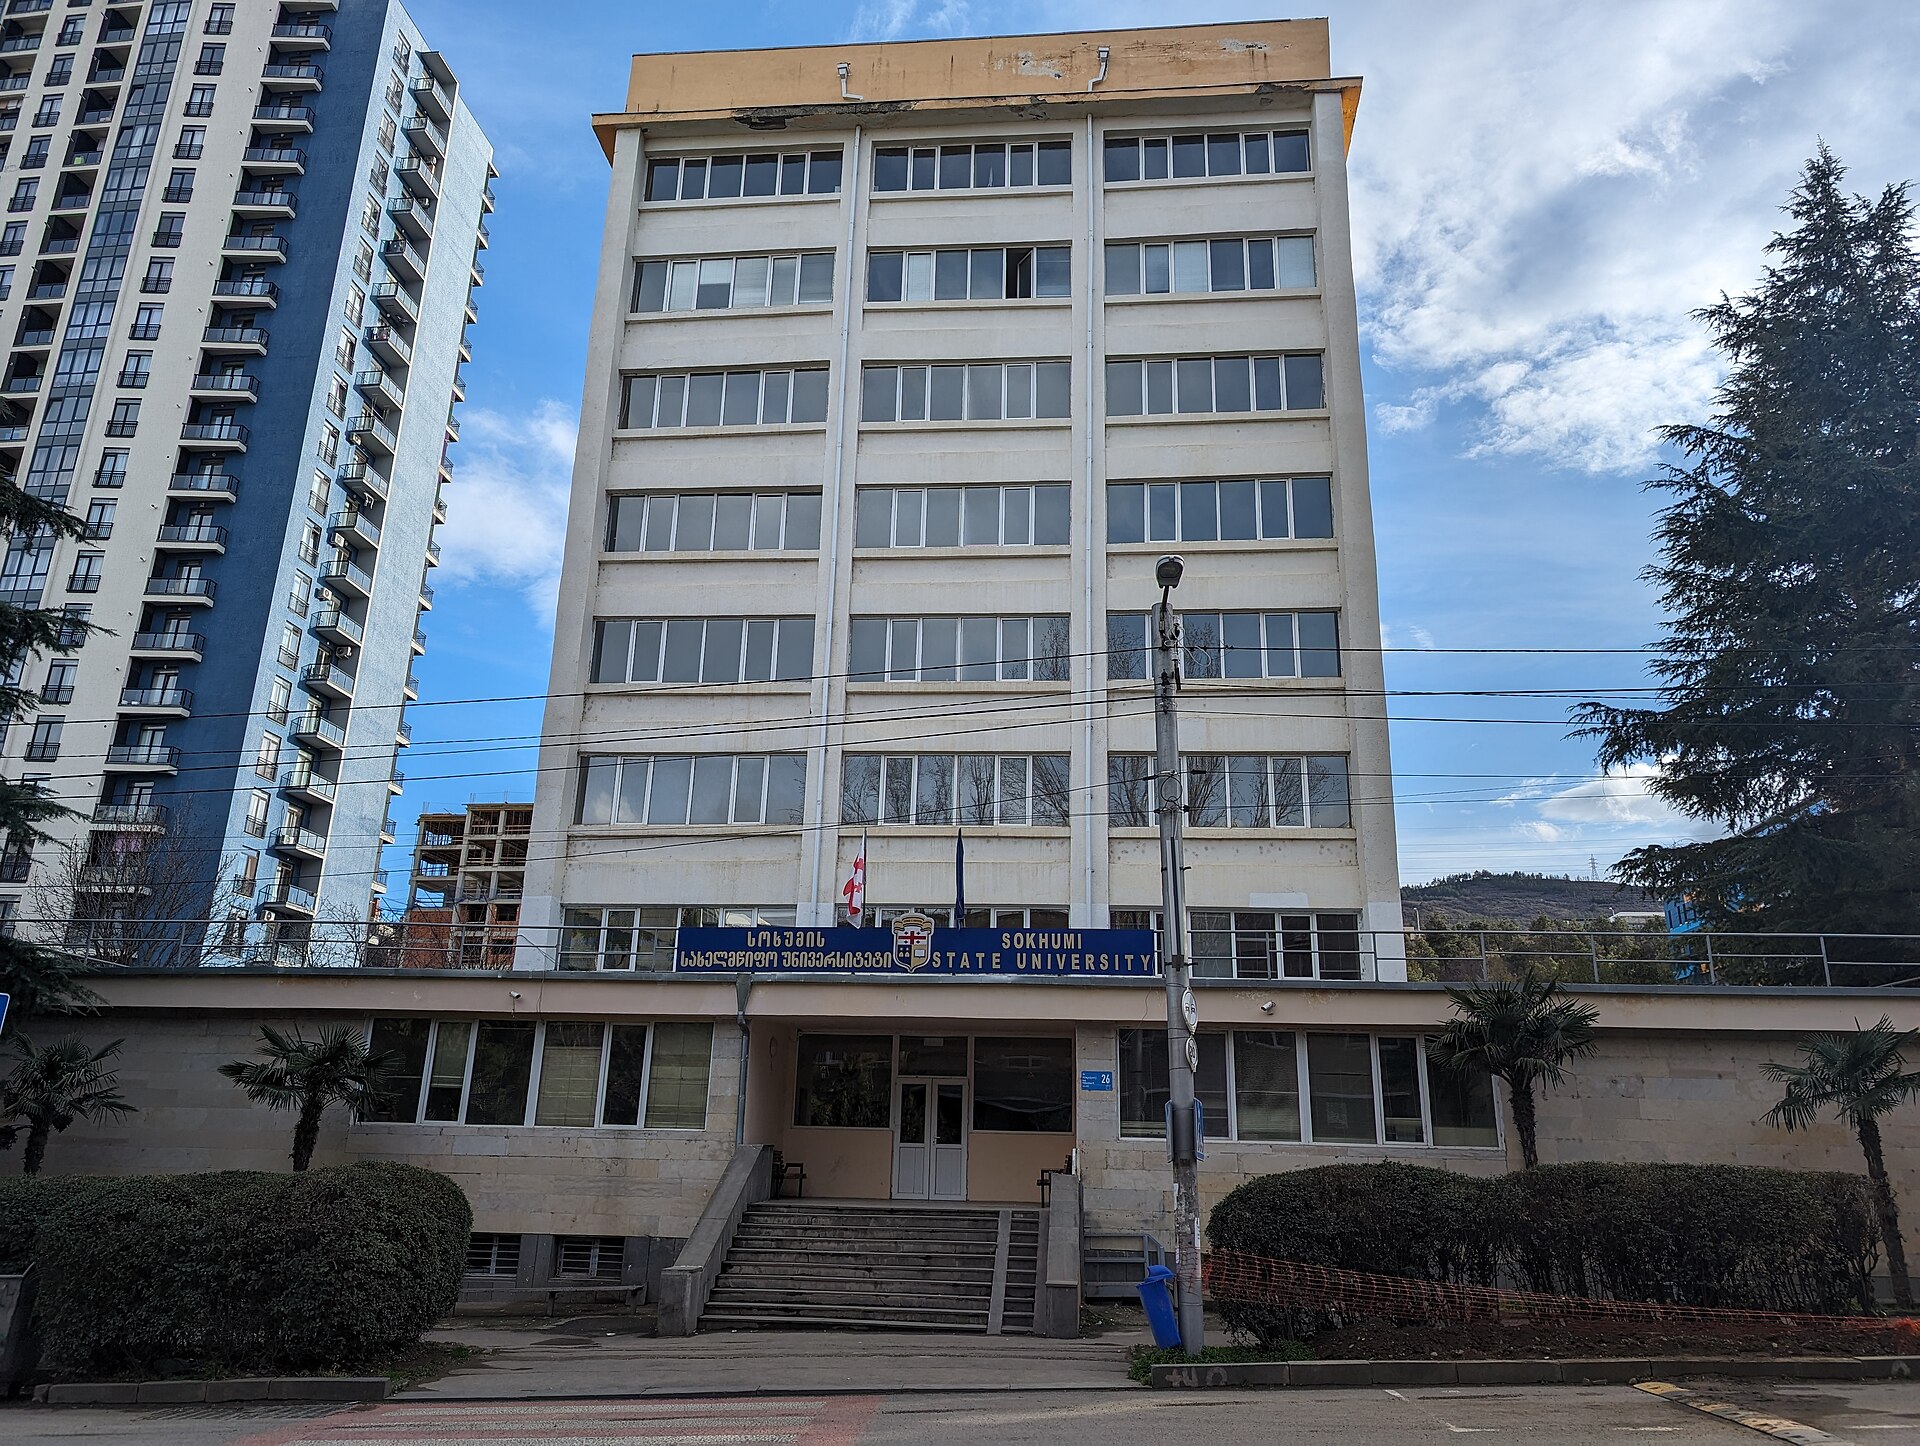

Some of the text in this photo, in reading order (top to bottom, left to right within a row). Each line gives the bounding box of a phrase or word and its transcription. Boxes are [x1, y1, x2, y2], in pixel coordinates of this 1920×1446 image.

[747, 931, 825, 948] სოხუმის
[1001, 932, 1082, 949] SOKHUMI
[680, 951, 892, 968] სახელმწიფო უნივერსიტეტი
[932, 951, 1151, 971] STATE UNIVERSITY
[1101, 1074, 1110, 1084] 26
